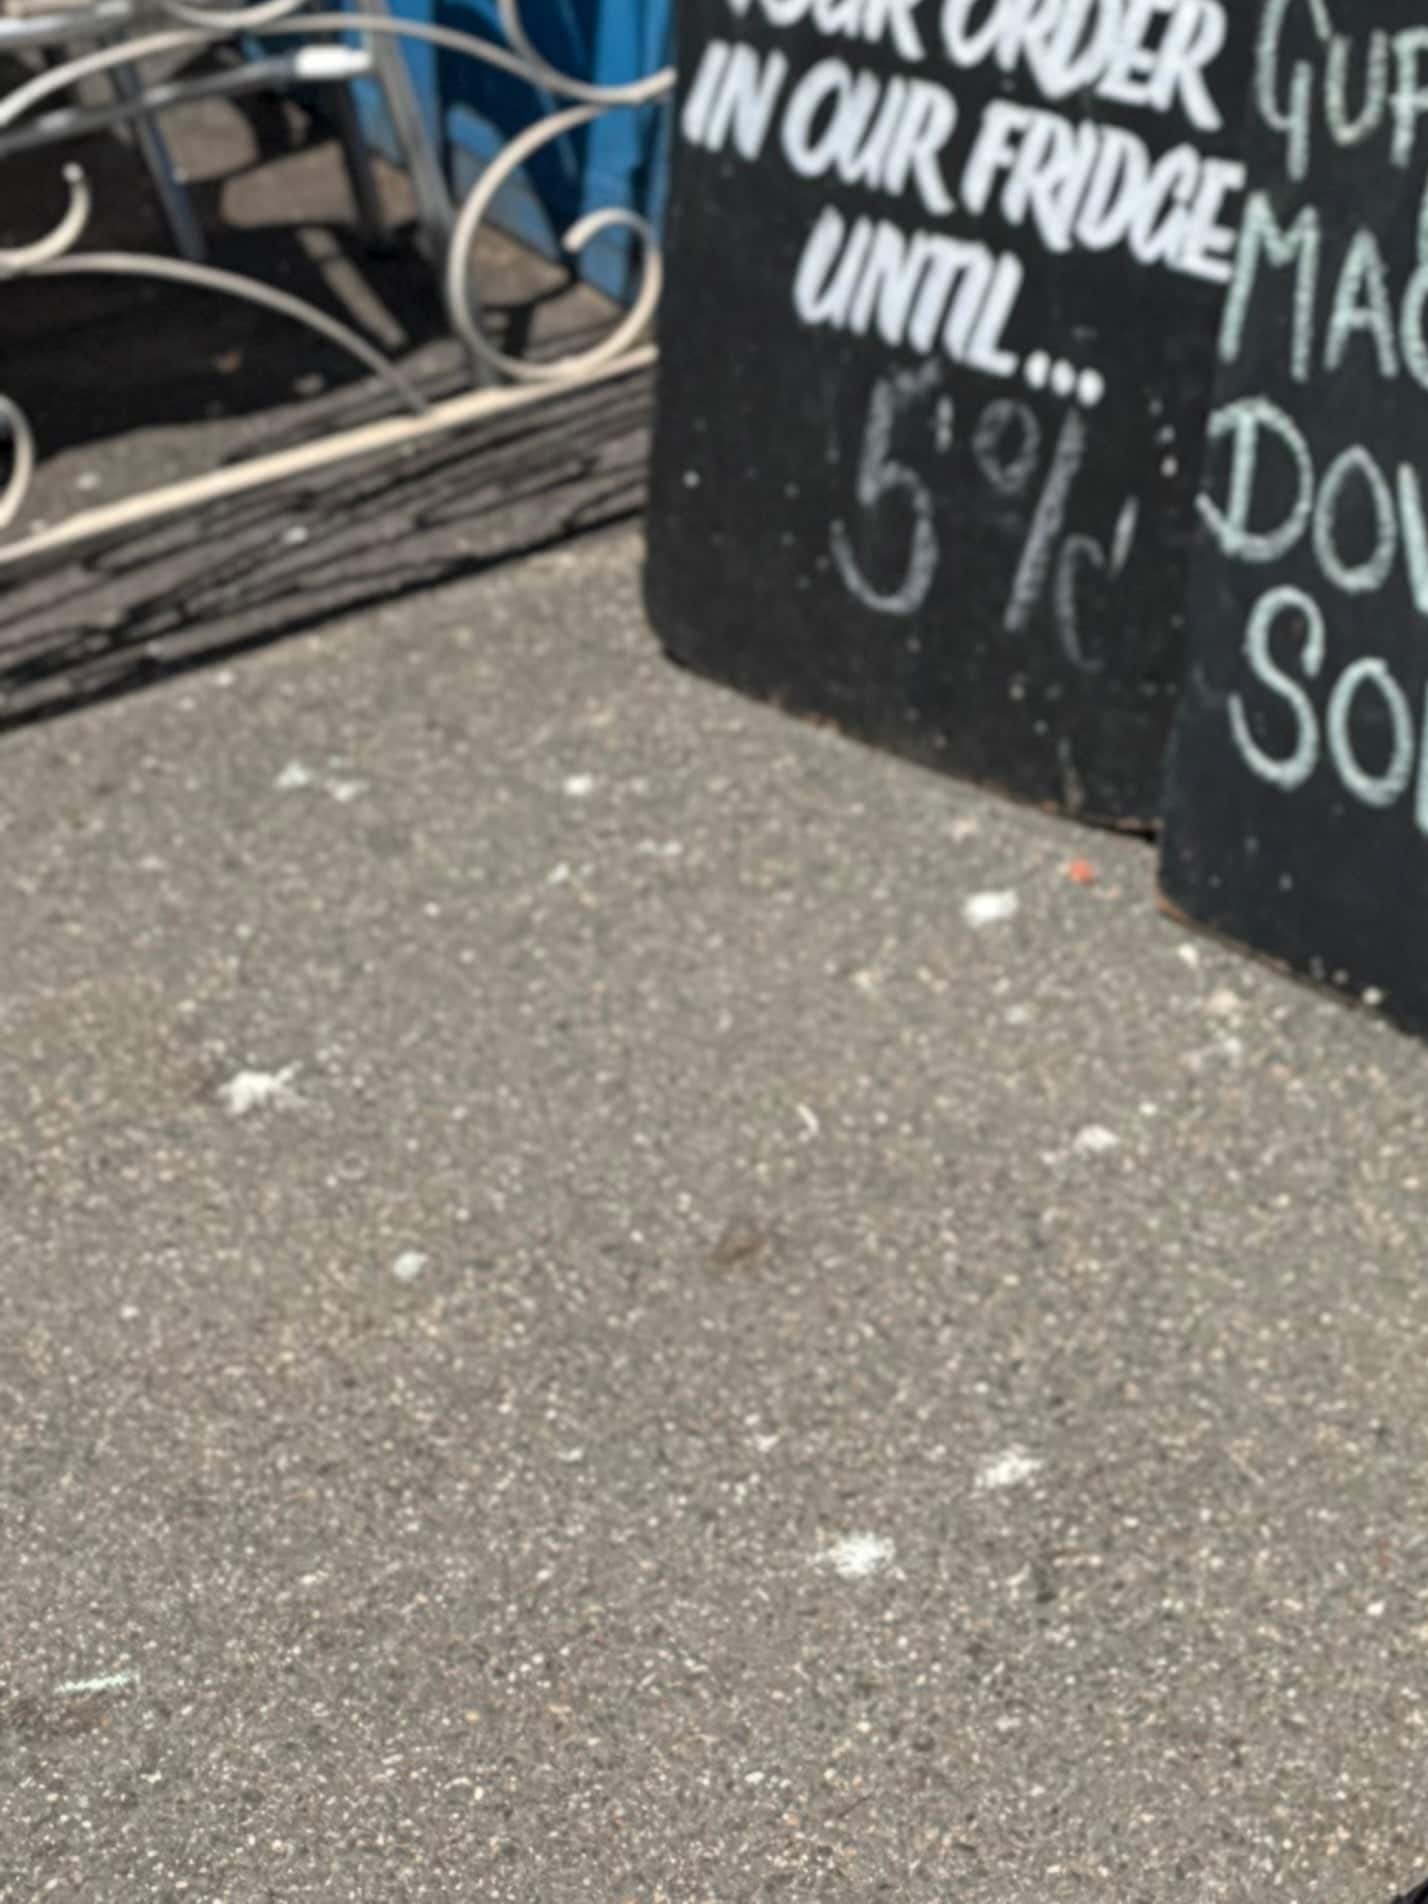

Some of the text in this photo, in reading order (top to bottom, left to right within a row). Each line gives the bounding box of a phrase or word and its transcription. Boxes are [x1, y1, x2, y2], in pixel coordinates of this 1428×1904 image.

[681, 38, 1247, 285] IN OUR FRIDGE
